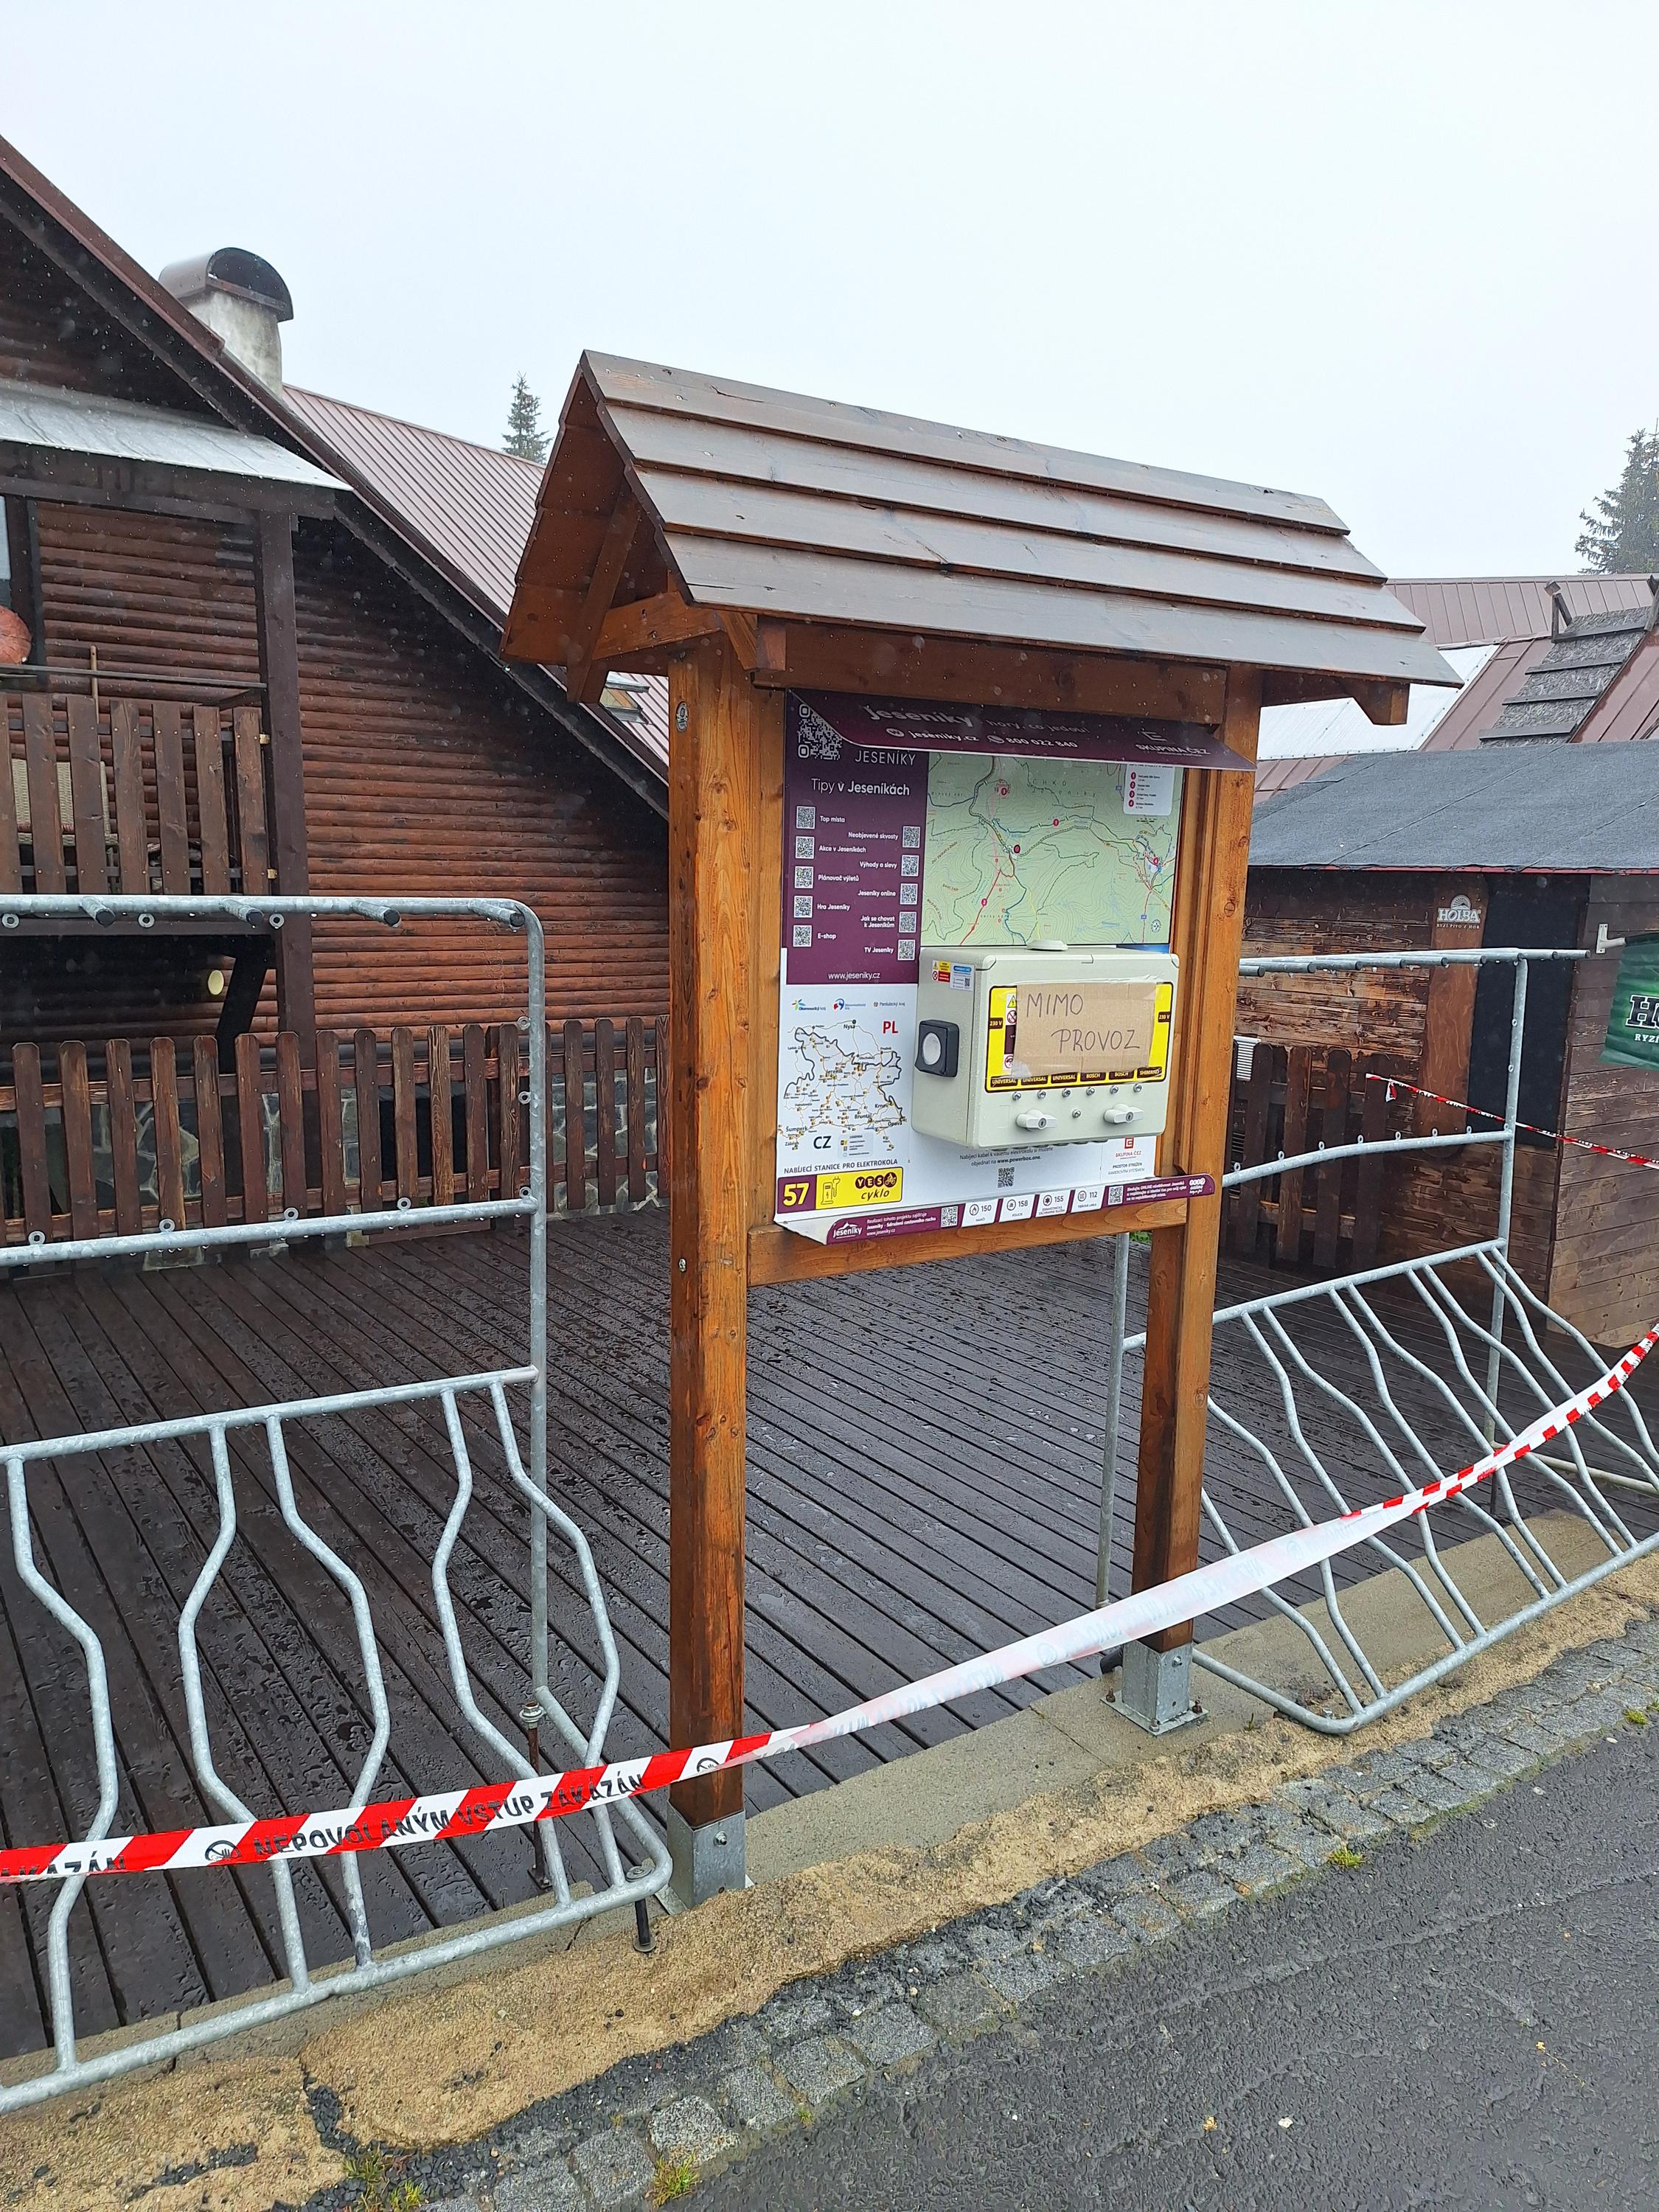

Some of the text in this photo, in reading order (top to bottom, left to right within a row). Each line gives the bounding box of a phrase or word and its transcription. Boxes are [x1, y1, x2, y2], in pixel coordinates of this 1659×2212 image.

[908, 730, 979, 742] jeseniky.cz
[1006, 737, 1029, 745] 800
[1031, 739, 1054, 747] 022
[1135, 743, 1187, 754] SKUPINA
[1186, 745, 1211, 755] ČEZ
[855, 749, 917, 766] JESENÍKY
[812, 778, 910, 796] Tipy v Jeseníkách
[848, 832, 878, 840] Neobjevené
[860, 860, 879, 869] Výhody
[843, 874, 859, 883] výletů
[1437, 908, 1481, 923] HOLBA
[828, 972, 880, 981] www.jeseniky.cz
[1026, 992, 1084, 1018] MIMO
[883, 1020, 899, 1034] PL
[1051, 1029, 1140, 1054] PROVOZ
[813, 1135, 832, 1149] CZ
[784, 1164, 812, 1174] NABÍJECÍ
[814, 1162, 840, 1172] STANICE
[857, 1158, 898, 1168] ELEKTROKOLA
[856, 1177, 883, 1188] YES
[783, 1182, 810, 1206] 57
[861, 1189, 890, 1201] cyklo
[254, 1770, 644, 1857] NEPOVOLANÝM VSTUP ZAKÁZÁN
